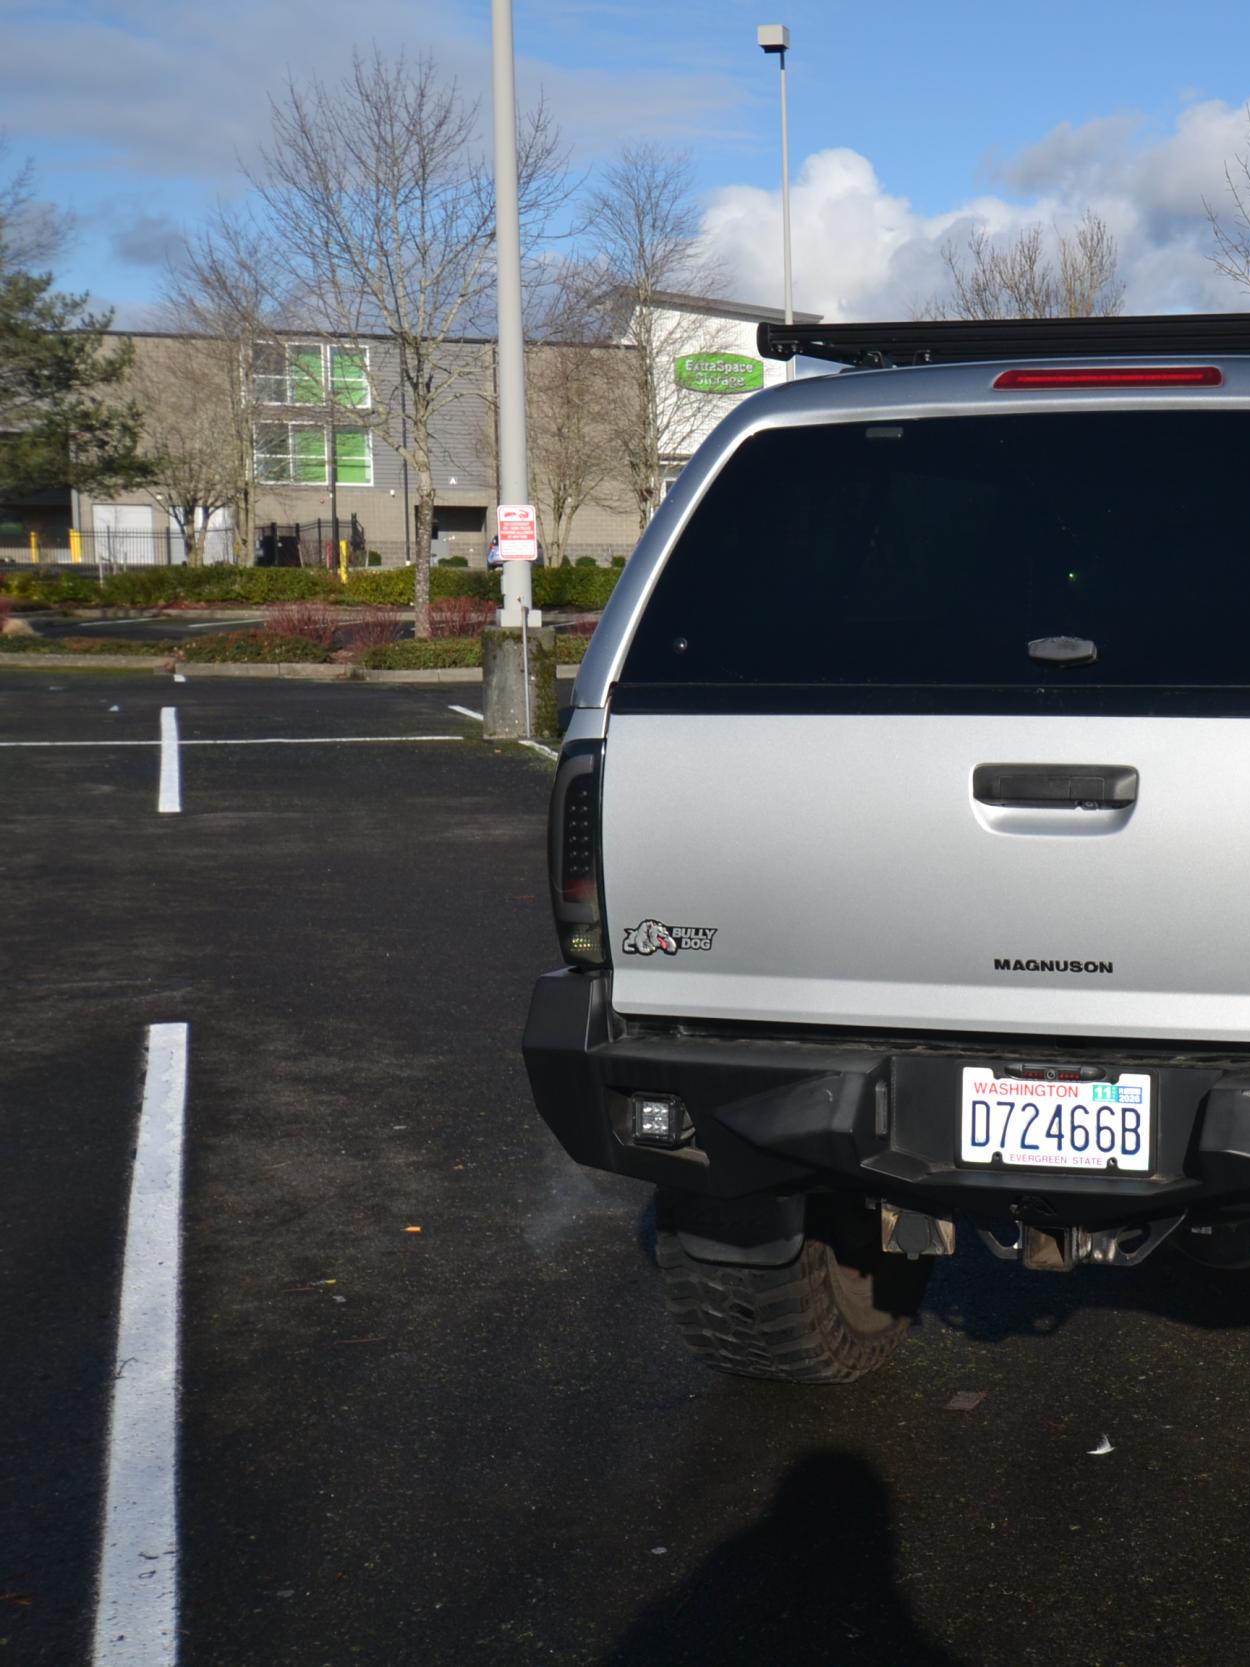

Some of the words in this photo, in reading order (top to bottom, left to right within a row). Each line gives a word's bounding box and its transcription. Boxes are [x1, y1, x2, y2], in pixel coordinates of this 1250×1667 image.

[695, 372, 745, 388] Storage
[672, 927, 715, 940] BULLY
[681, 939, 711, 950] DOG
[993, 958, 1114, 974] MAGNUSON
[974, 1081, 1079, 1099] WASHINGTON
[970, 1100, 1142, 1156] D72466B
[1009, 1153, 1068, 1165] EVERGREEN
[1072, 1157, 1103, 1167] STATE
